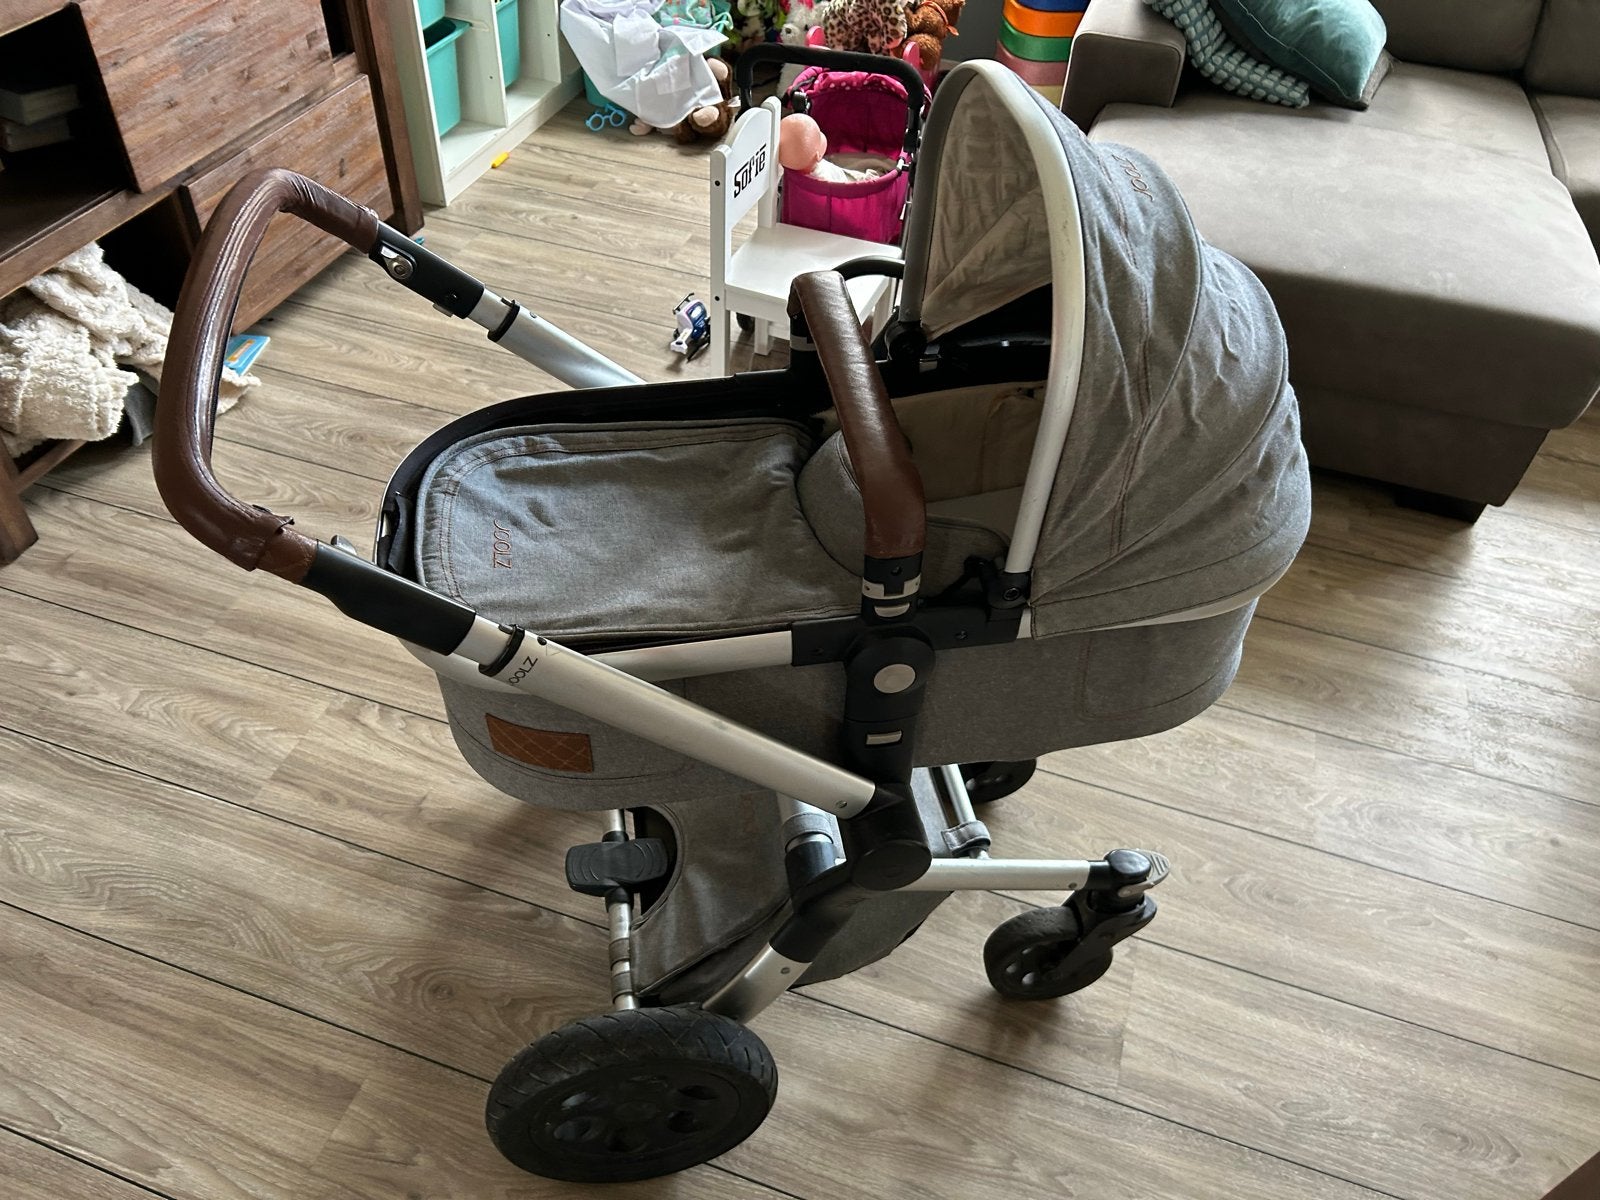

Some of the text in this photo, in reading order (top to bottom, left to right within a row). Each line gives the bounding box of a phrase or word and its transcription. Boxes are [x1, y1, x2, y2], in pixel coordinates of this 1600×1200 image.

[733, 143, 767, 199] Sofie
[492, 519, 512, 570] JOOLZ
[508, 655, 539, 686] OOLZ
